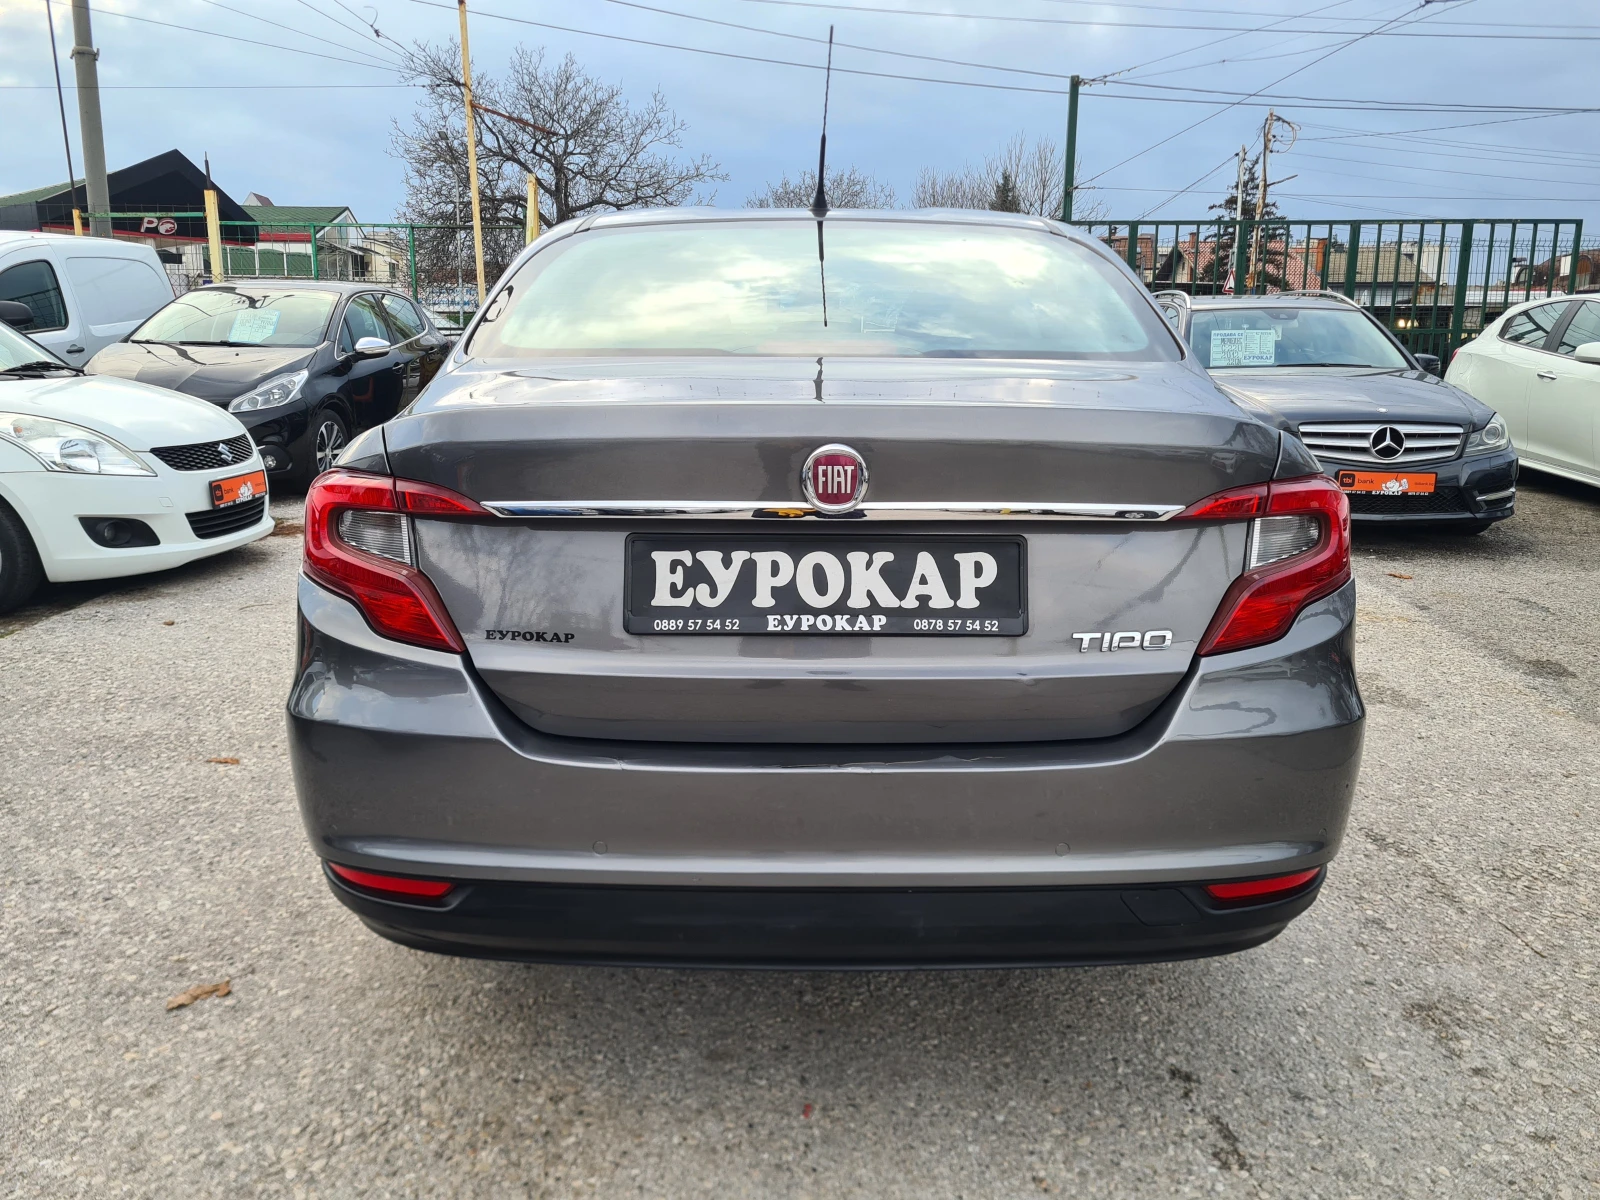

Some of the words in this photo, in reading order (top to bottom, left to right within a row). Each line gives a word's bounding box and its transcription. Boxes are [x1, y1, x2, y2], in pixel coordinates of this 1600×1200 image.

[817, 465, 855, 494] FIAT
[650, 550, 998, 608] ЕУРОКАР
[653, 619, 684, 631] 0889
[687, 619, 702, 630] 57
[706, 619, 721, 630] 54
[724, 619, 740, 630] 52
[766, 614, 887, 631] ЕУРОКАР
[913, 619, 944, 631] 0878
[947, 619, 962, 631] 57
[965, 619, 980, 631] 54
[984, 620, 999, 631] 52
[485, 629, 575, 643] ЕУРОКАР
[1071, 630, 1173, 653] TIPO
